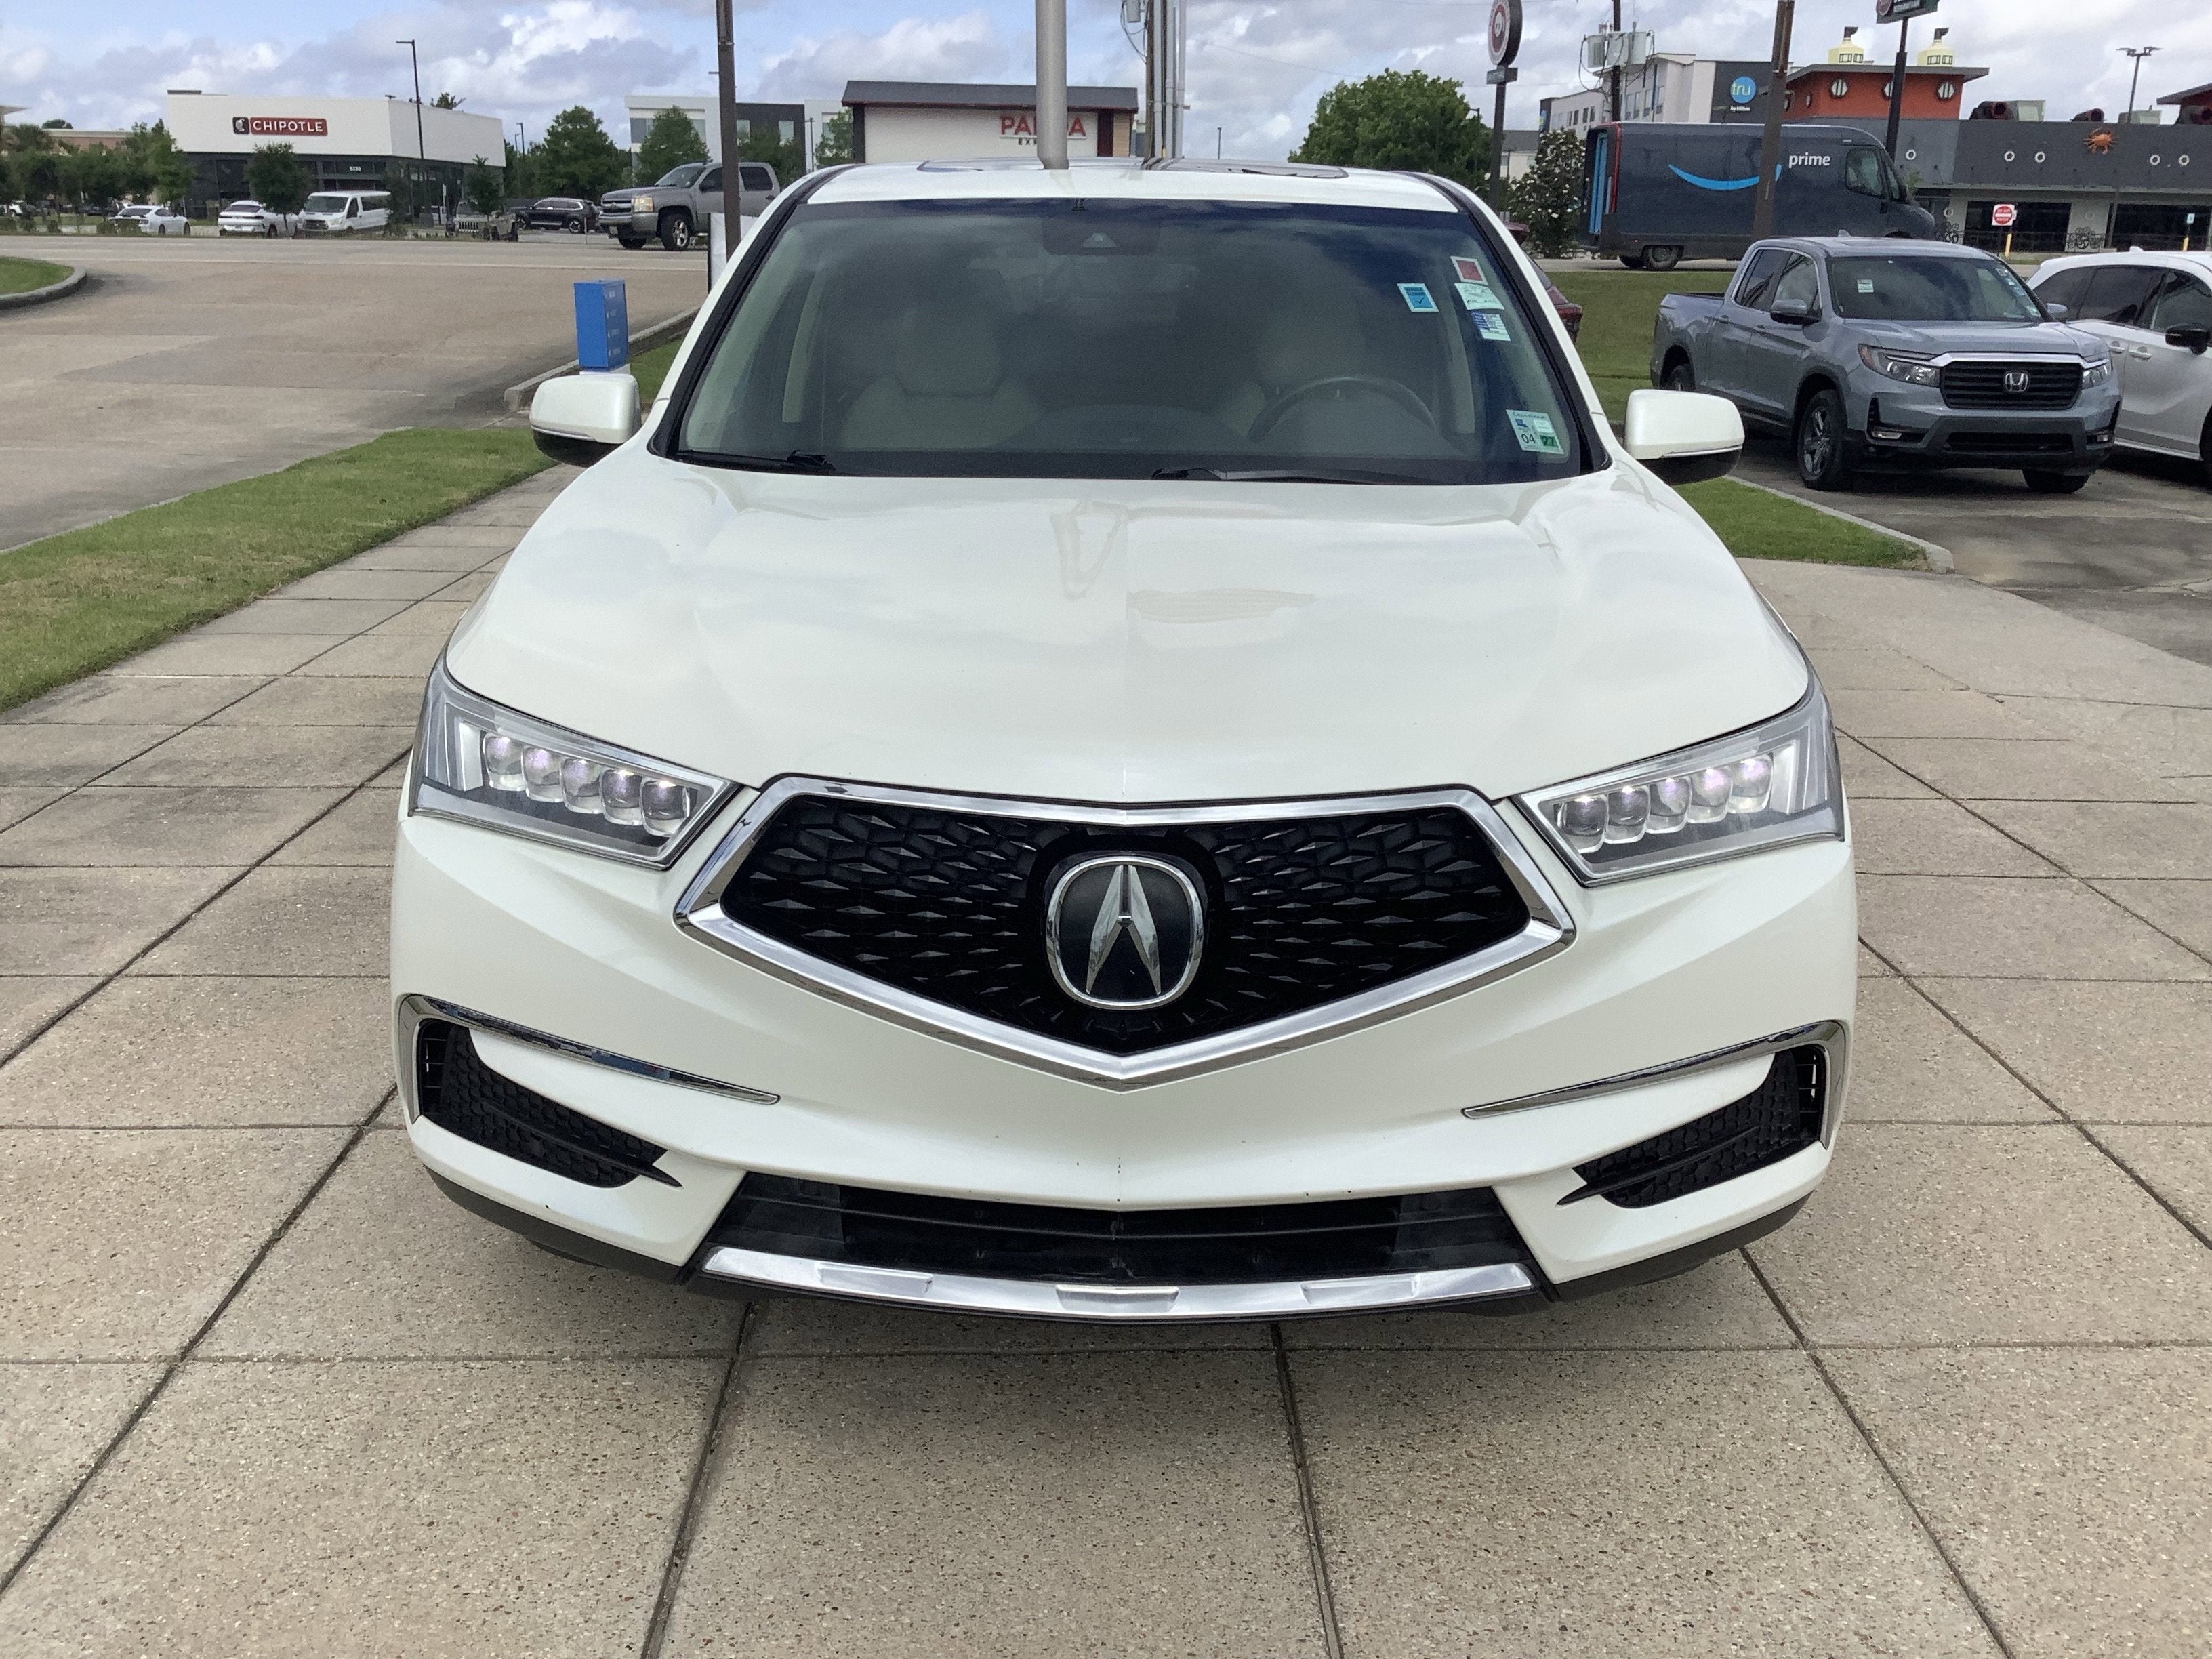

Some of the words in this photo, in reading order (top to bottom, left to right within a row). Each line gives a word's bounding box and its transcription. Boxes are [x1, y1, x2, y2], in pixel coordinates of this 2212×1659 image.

[1732, 82, 1751, 96] tru
[253, 120, 323, 132] CHIPOTLE
[1000, 115, 1086, 136] PAA
[1788, 151, 1831, 169] prime
[1521, 434, 1536, 444] 04
[1540, 436, 1555, 445] 27
